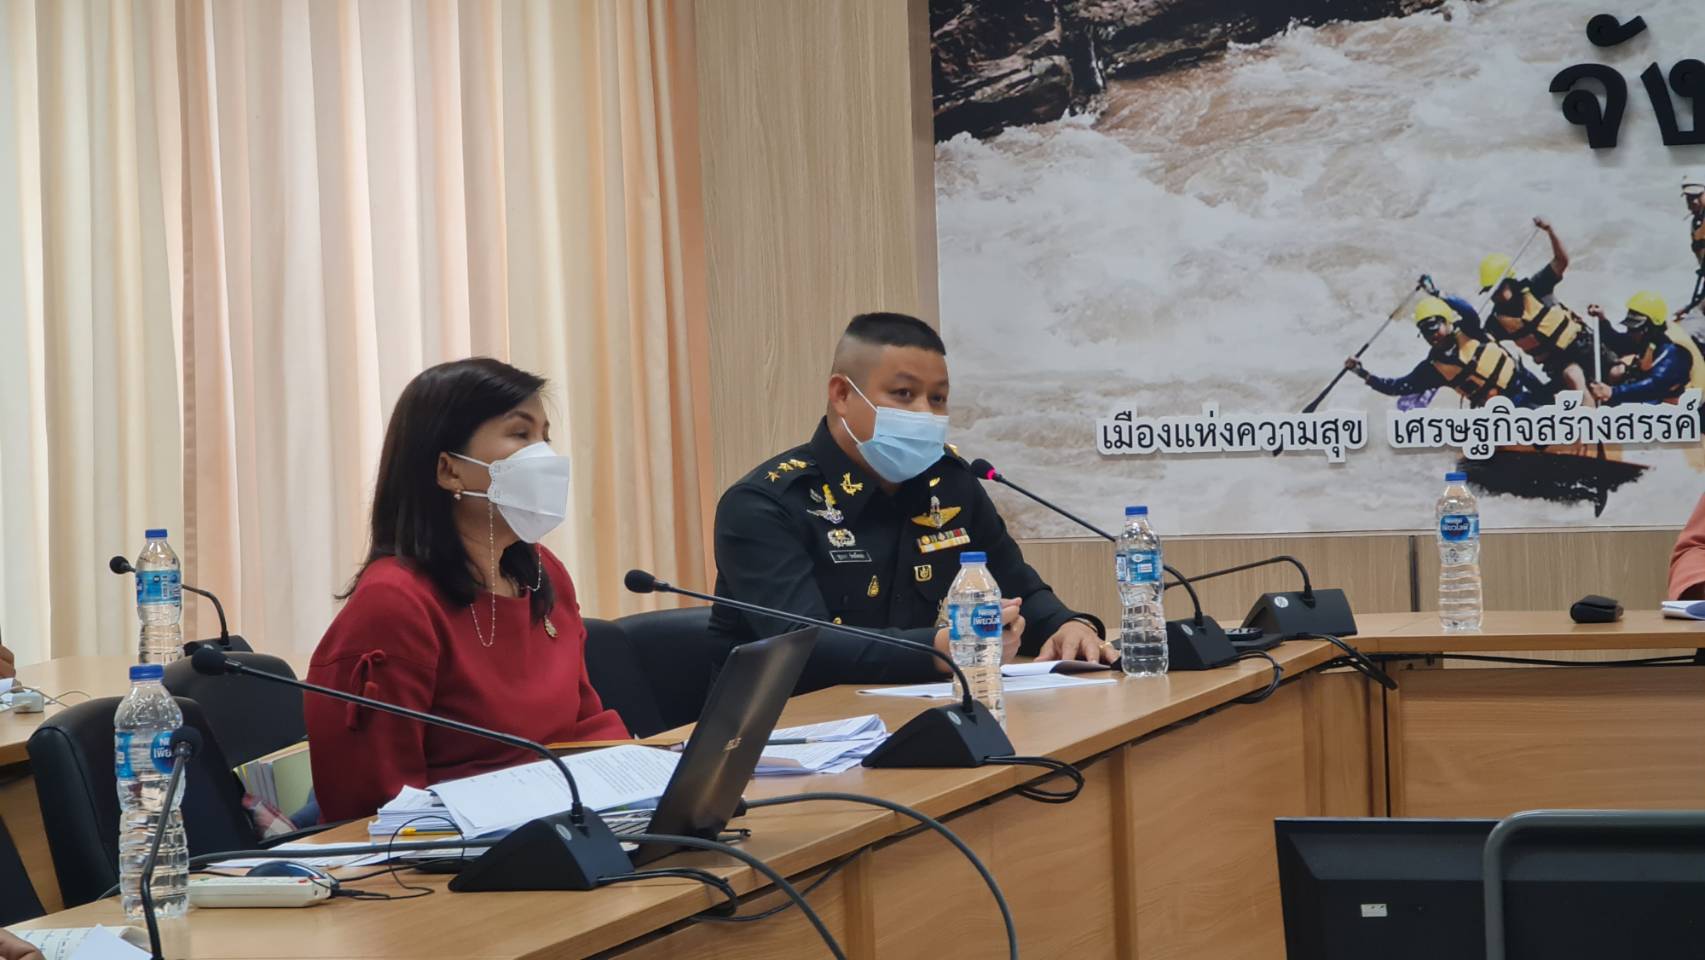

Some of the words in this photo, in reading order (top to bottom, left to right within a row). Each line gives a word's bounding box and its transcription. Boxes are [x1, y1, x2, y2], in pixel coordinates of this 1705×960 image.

[1103, 410, 1362, 458] เมืองแห่งความสุข
[1394, 399, 1697, 455] เศรษฐกิจสร้างสรรค์
